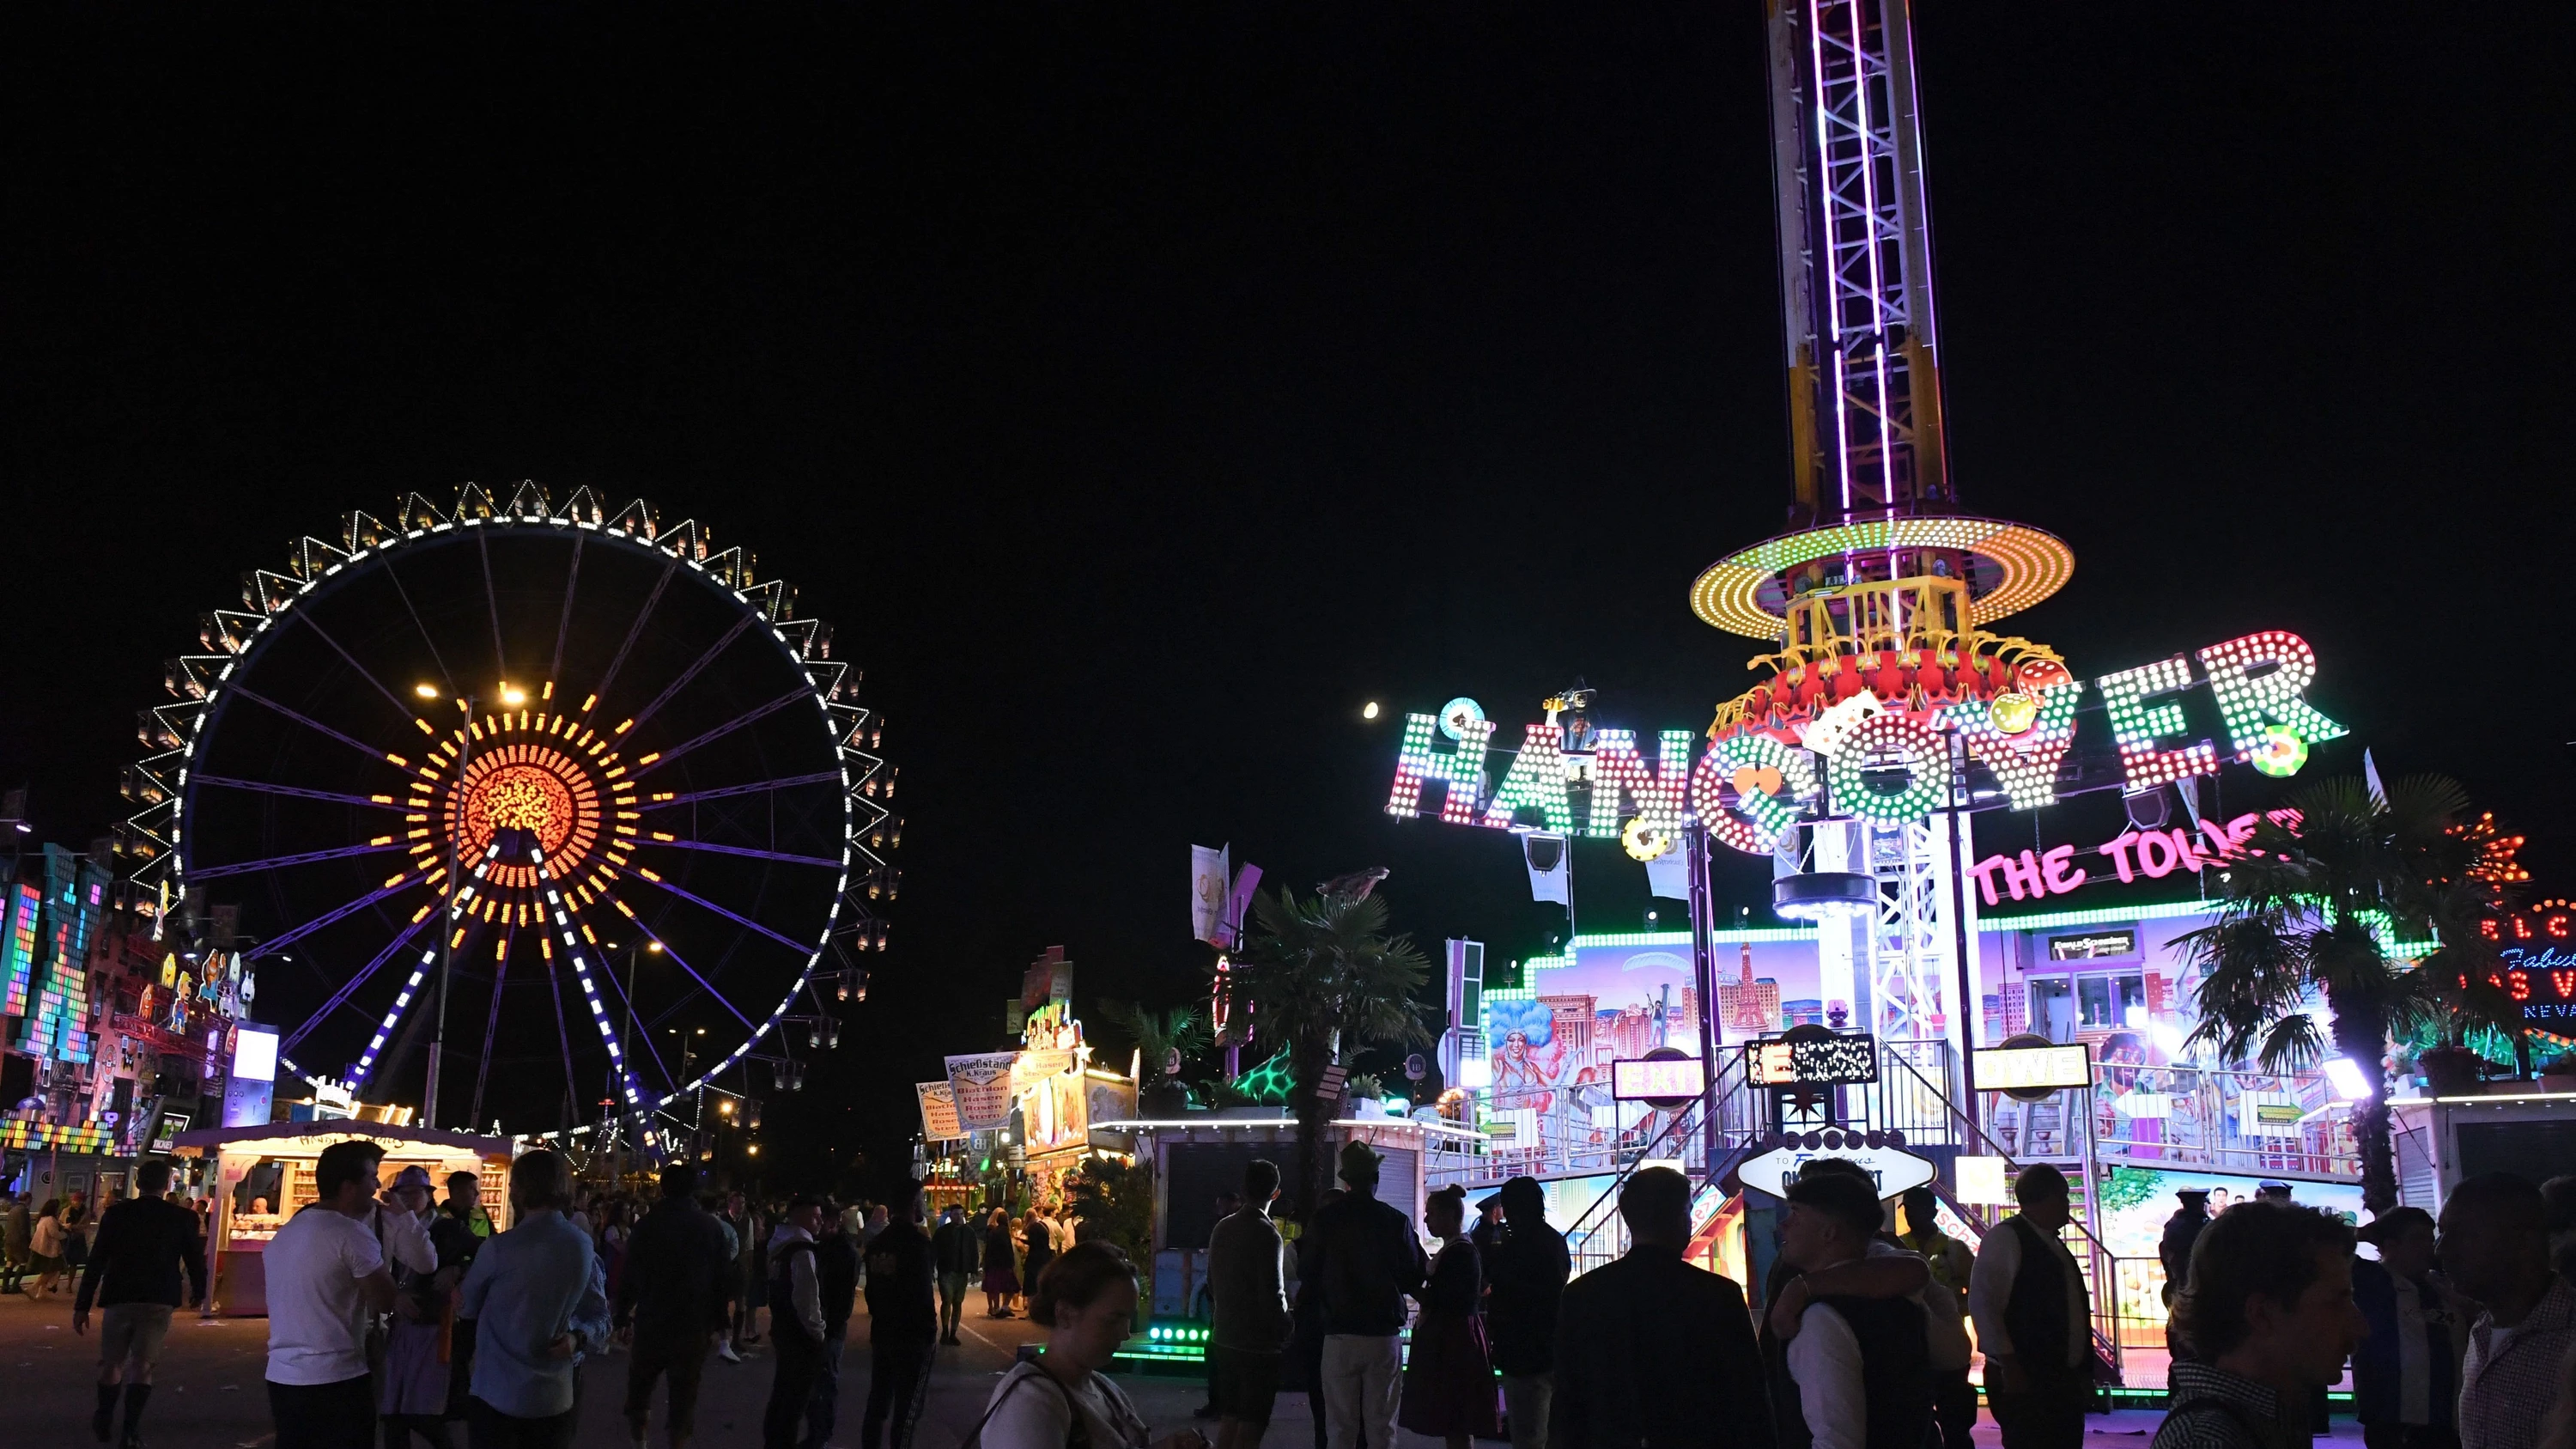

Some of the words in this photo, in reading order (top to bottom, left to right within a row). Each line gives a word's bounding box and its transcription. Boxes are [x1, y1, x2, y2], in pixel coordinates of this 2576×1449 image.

[1384, 630, 2349, 855] HANGOVER
[1965, 844, 2086, 905] THE
[2500, 947, 2576, 970] Fabu
[949, 1059, 1012, 1076] Schießstand
[957, 1086, 1007, 1094] Biathlon
[968, 1112, 1000, 1121] Stern
[1765, 1133, 1901, 1148] WELCOME
